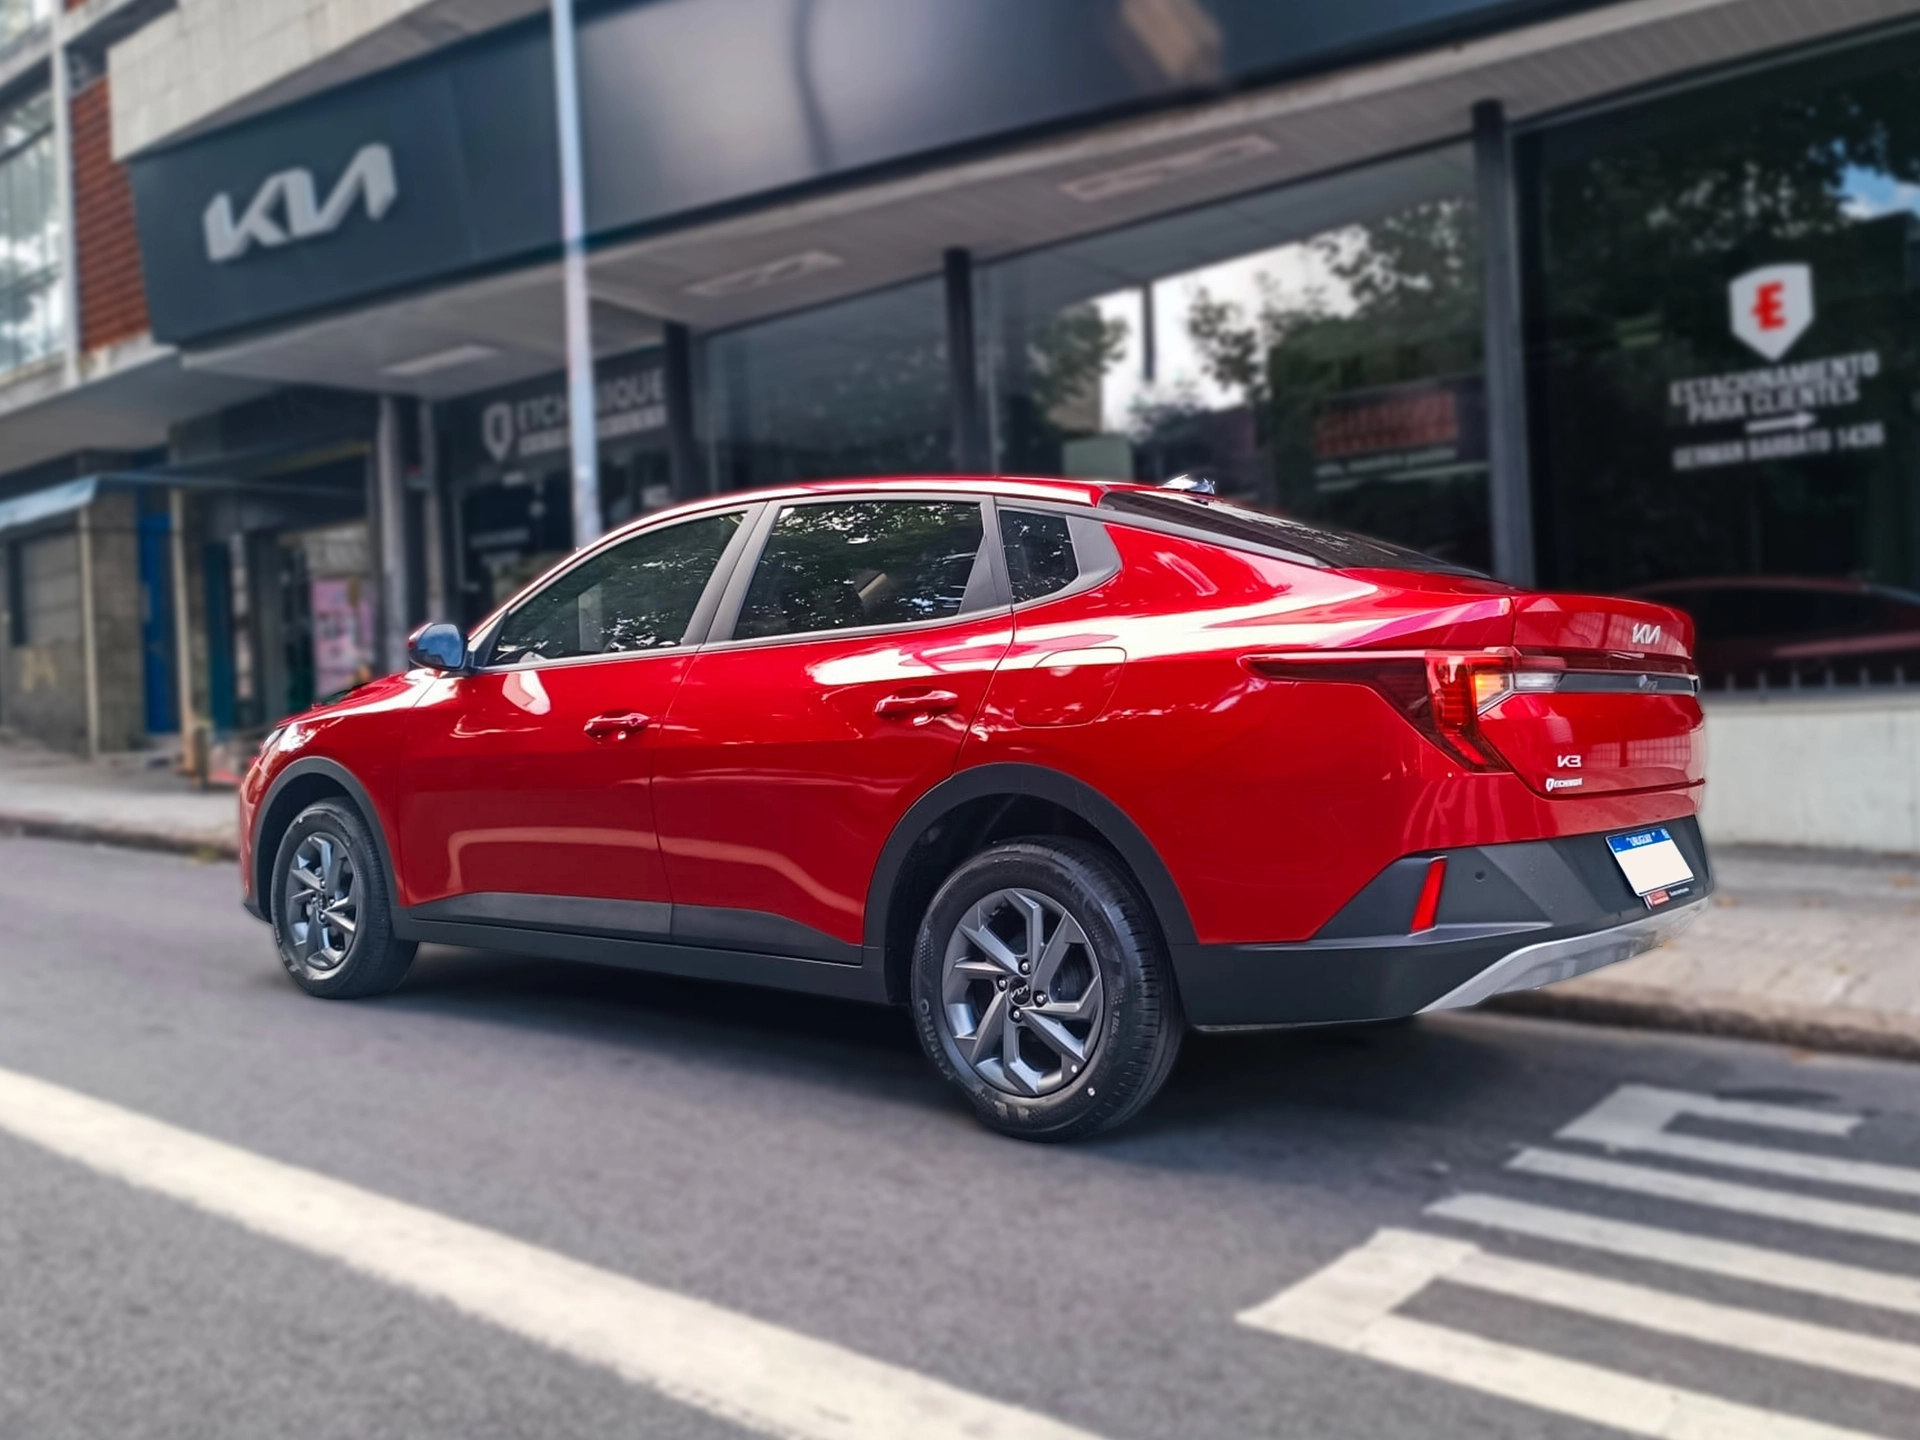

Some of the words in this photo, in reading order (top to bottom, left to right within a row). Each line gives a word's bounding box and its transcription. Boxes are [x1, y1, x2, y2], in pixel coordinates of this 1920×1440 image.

[203, 141, 396, 262] KIA
[1669, 351, 1880, 406] ESTACIONAMIENTO
[1687, 390, 1746, 424] PARA
[1750, 377, 1860, 415] CLIENTES
[1631, 622, 1661, 645] KIA
[1557, 754, 1582, 768] K3
